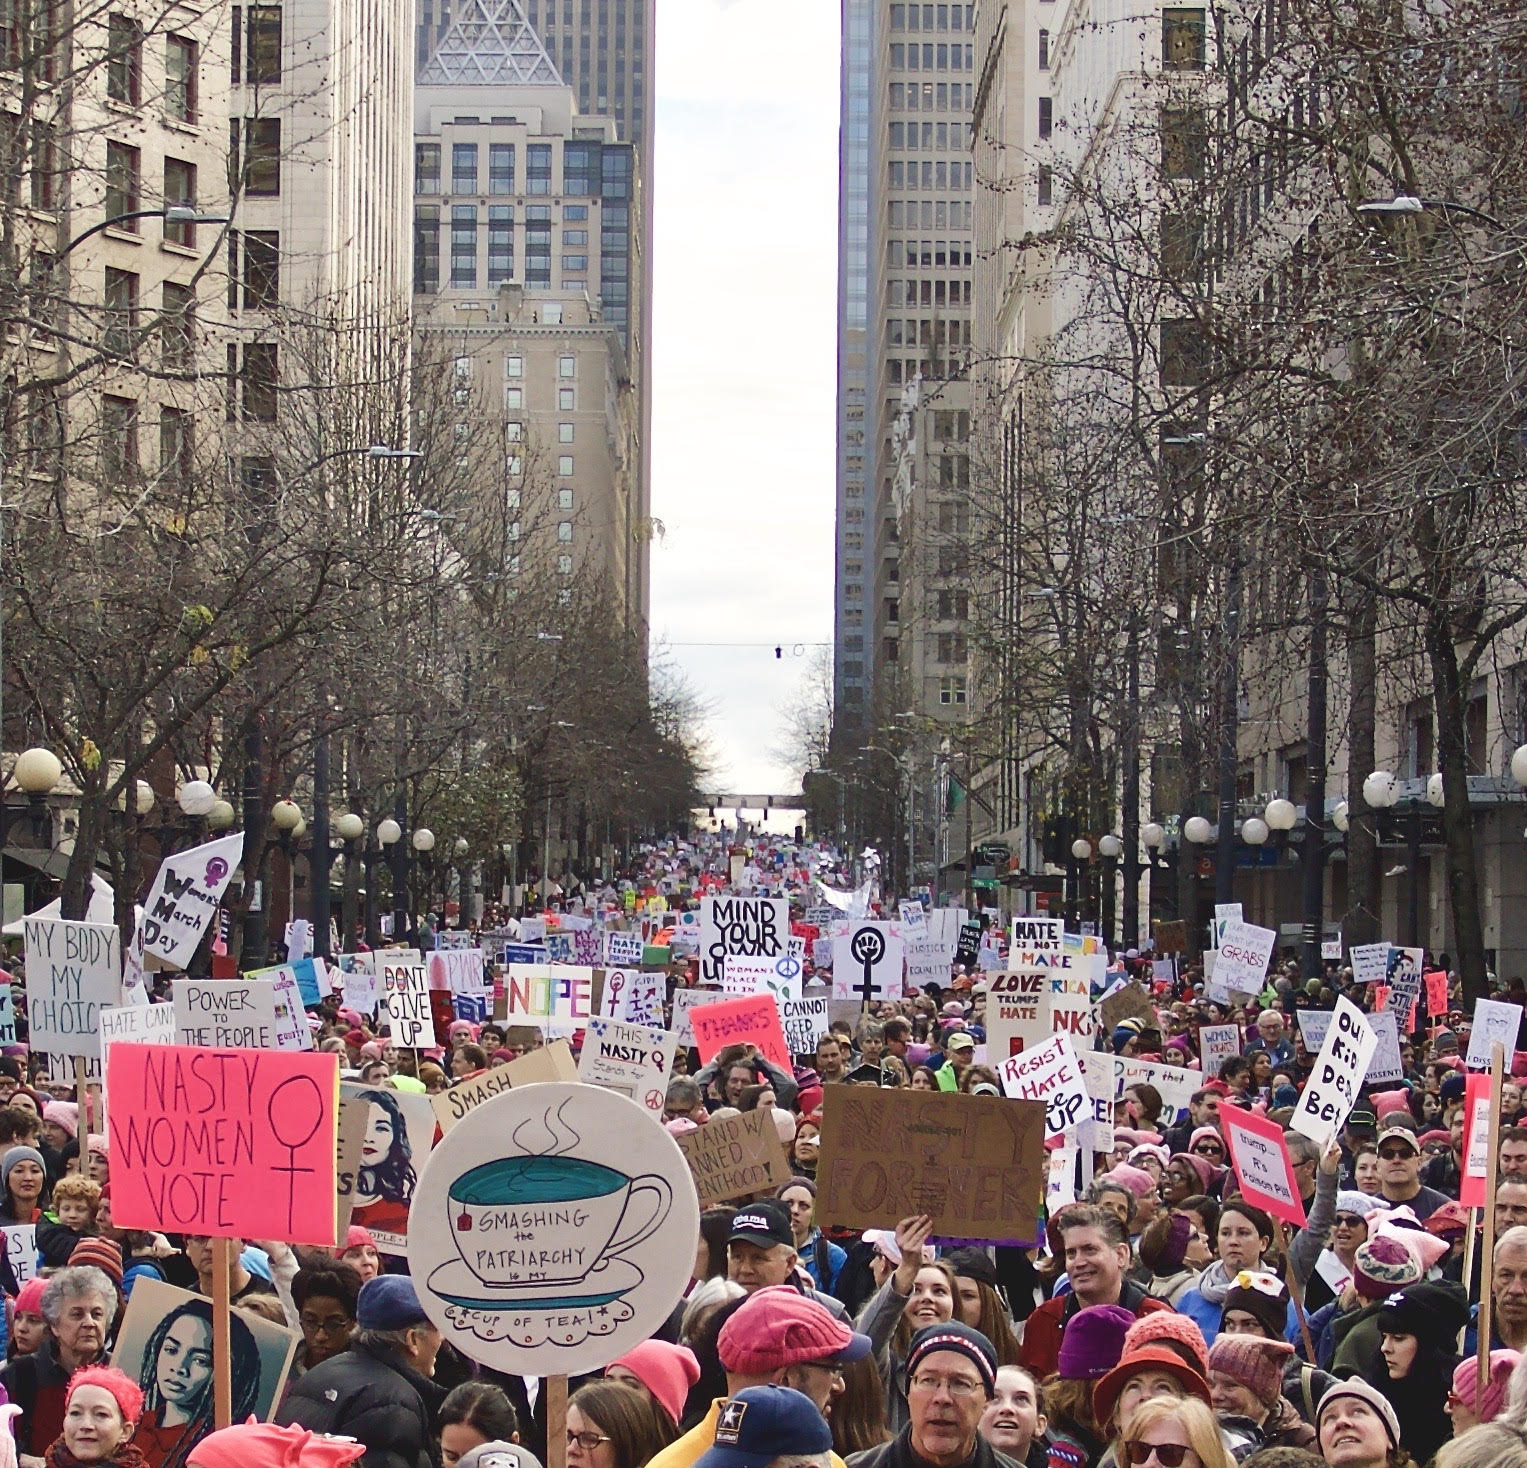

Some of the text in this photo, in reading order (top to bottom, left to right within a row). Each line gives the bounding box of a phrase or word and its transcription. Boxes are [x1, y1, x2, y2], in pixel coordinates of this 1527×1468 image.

[151, 897, 202, 931] March
[713, 900, 776, 924] MIND
[144, 919, 180, 955] Day
[713, 920, 782, 950] YOUR
[1015, 921, 1058, 940] HATE
[25, 921, 115, 969] MY BODY
[1222, 945, 1266, 968] GRABS
[1022, 952, 1072, 968] MAKE
[52, 964, 83, 999] MY
[448, 953, 483, 993] PWR
[990, 974, 1046, 993] LOVE
[188, 988, 257, 1011] POWER
[509, 977, 591, 1018] NOPE
[997, 995, 1039, 1004] TRUMPS
[1049, 980, 1088, 995] RICA
[32, 999, 114, 1034] CHOIC
[212, 1013, 228, 1023] TO
[388, 993, 430, 1020] GIVE
[784, 1000, 827, 1016] CANNOT
[1000, 1007, 1037, 1019] HATE
[102, 1011, 137, 1037] HATE
[401, 1022, 423, 1047] UP
[614, 1025, 643, 1044] THIS
[182, 1028, 210, 1047] THE
[216, 1026, 271, 1048] PEOPLE
[600, 1042, 647, 1063] NASTY
[144, 1052, 260, 1115] NASTY
[447, 1073, 513, 1120] SMASH
[110, 1117, 255, 1169] WOMEN
[839, 1100, 1038, 1165] NASTY
[141, 1171, 234, 1228] VOTE
[828, 1158, 1040, 1223] FOREVER
[478, 1208, 591, 1232] SMASHING
[513, 1231, 535, 1242] the
[476, 1246, 587, 1270] PATRIARCHY
[528, 1271, 548, 1282] MY
[472, 1311, 594, 1328] CUP OF TEA!
